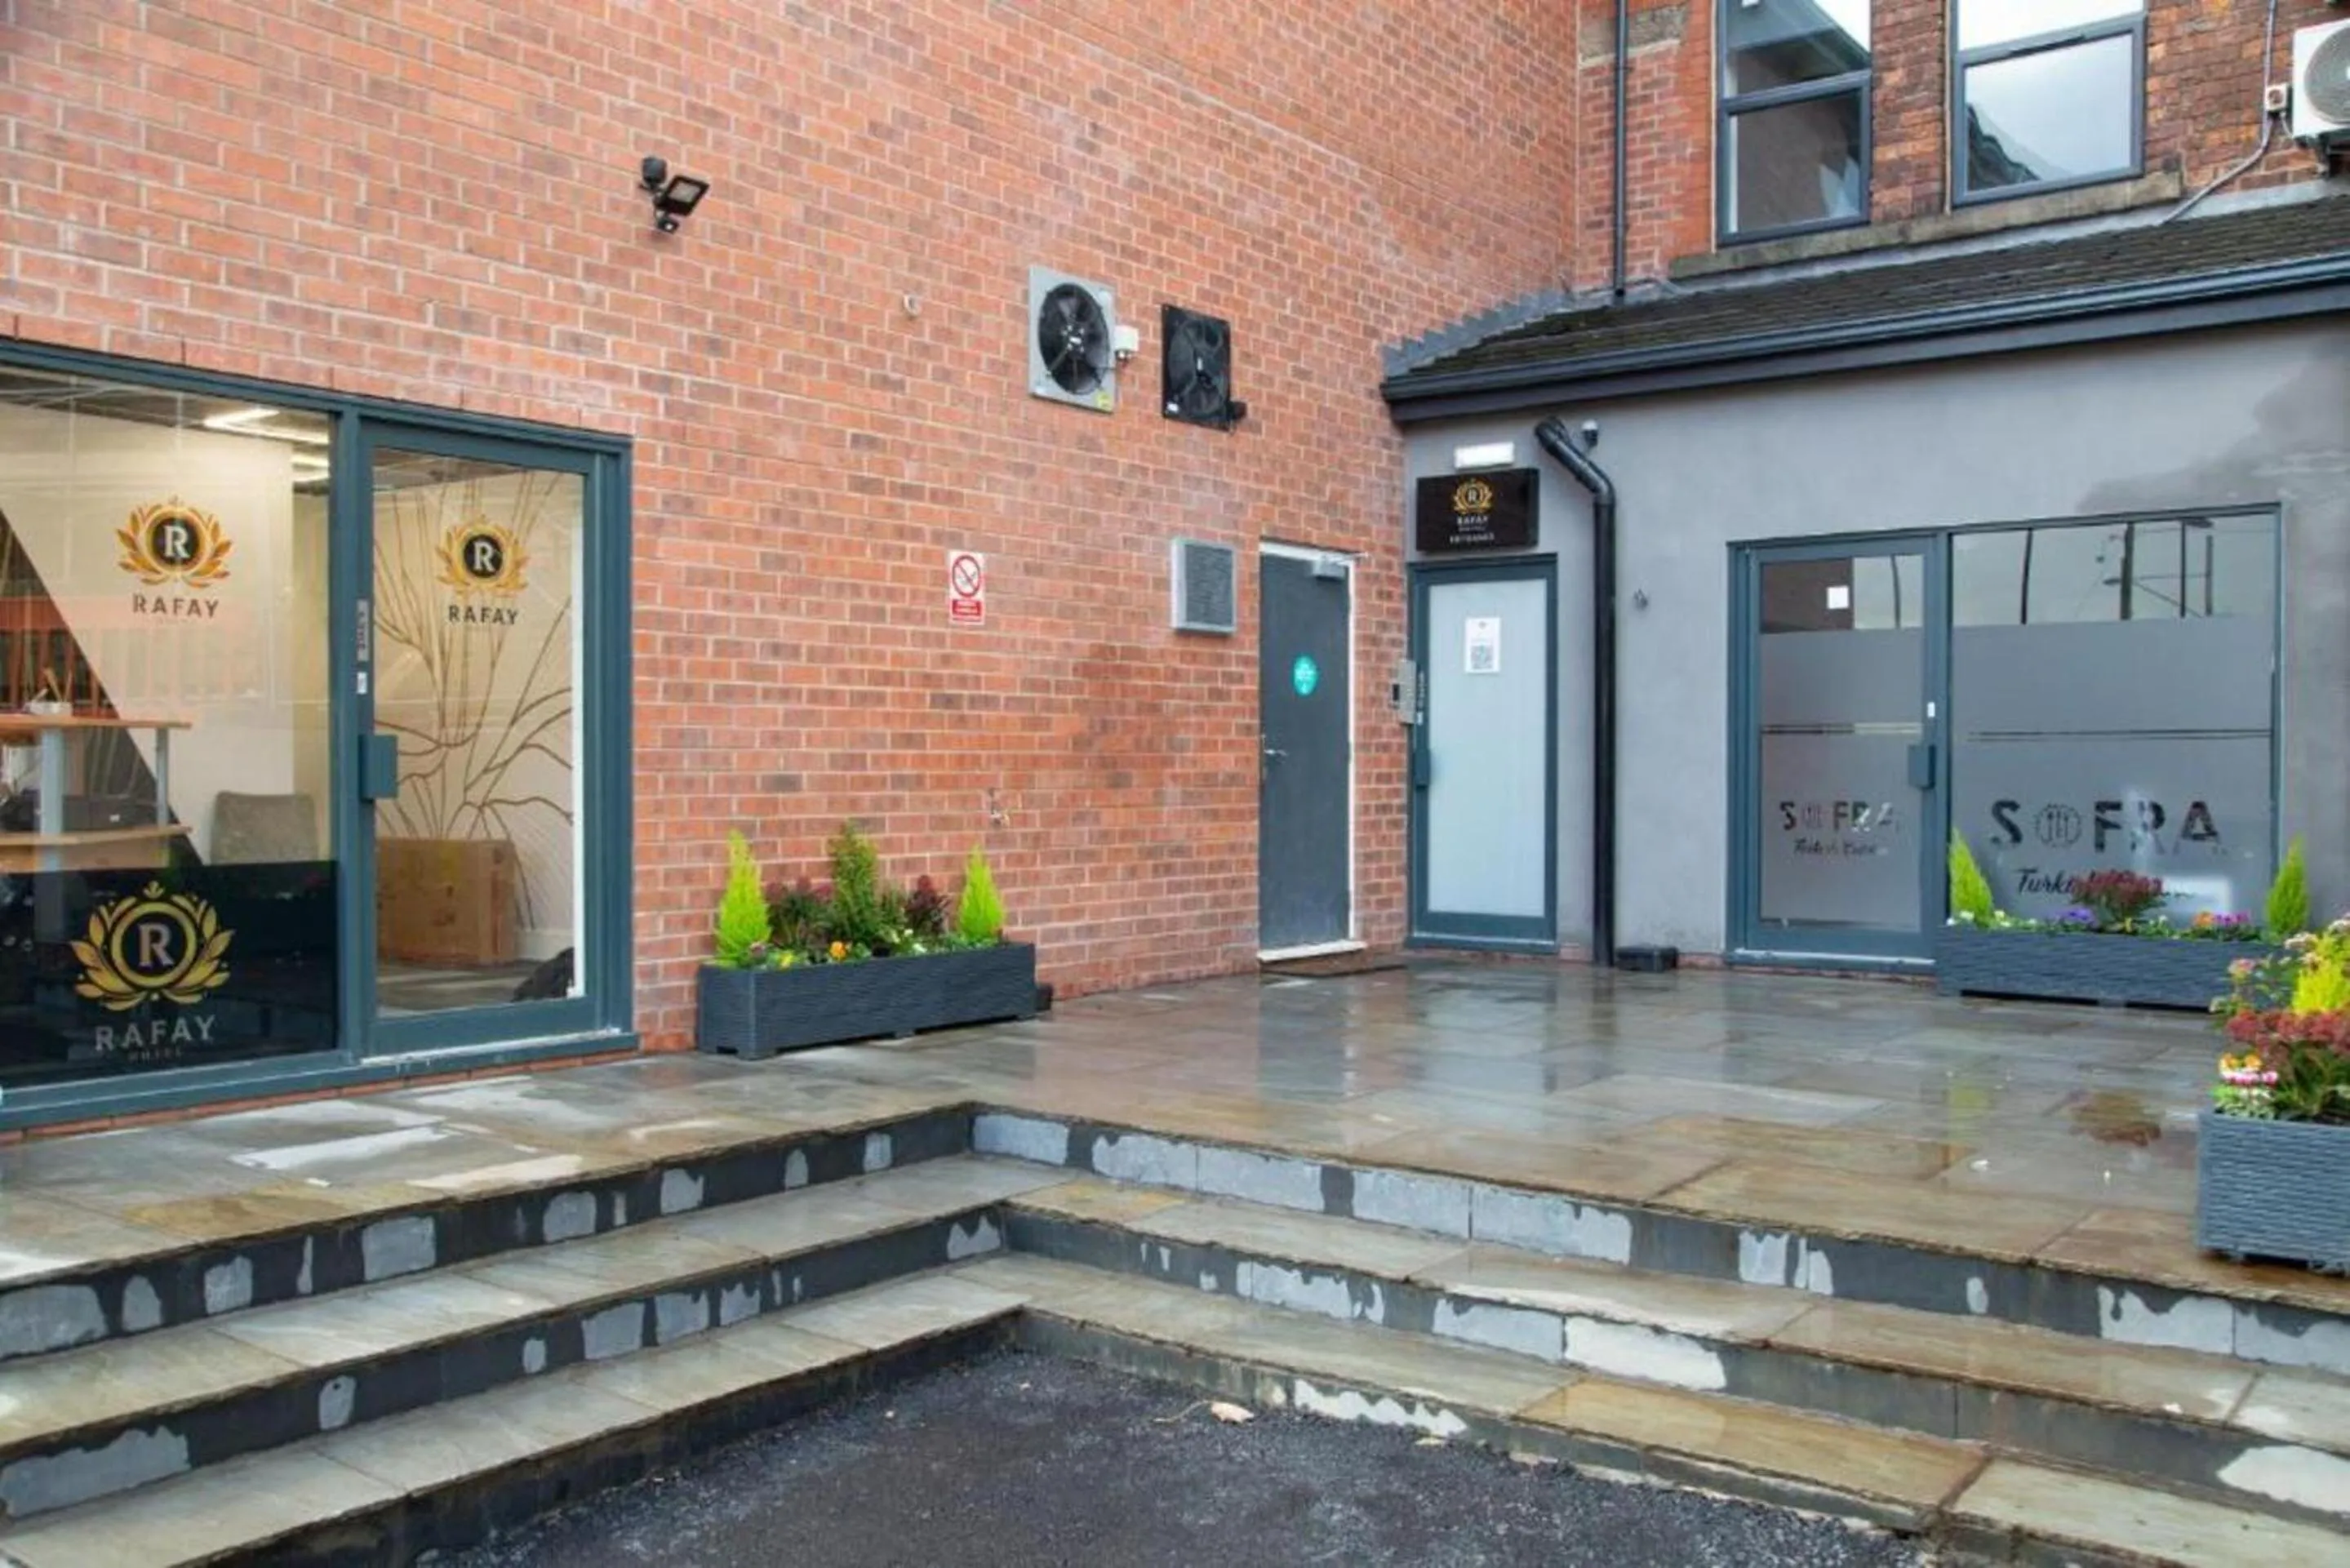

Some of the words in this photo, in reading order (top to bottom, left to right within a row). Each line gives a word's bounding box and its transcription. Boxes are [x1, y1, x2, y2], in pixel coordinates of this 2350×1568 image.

[164, 525, 190, 558] R
[474, 541, 495, 572] R
[132, 592, 219, 617] RAFAY
[448, 605, 519, 624] RAFAY
[138, 922, 175, 967] R
[95, 1015, 215, 1051] RAFAY
